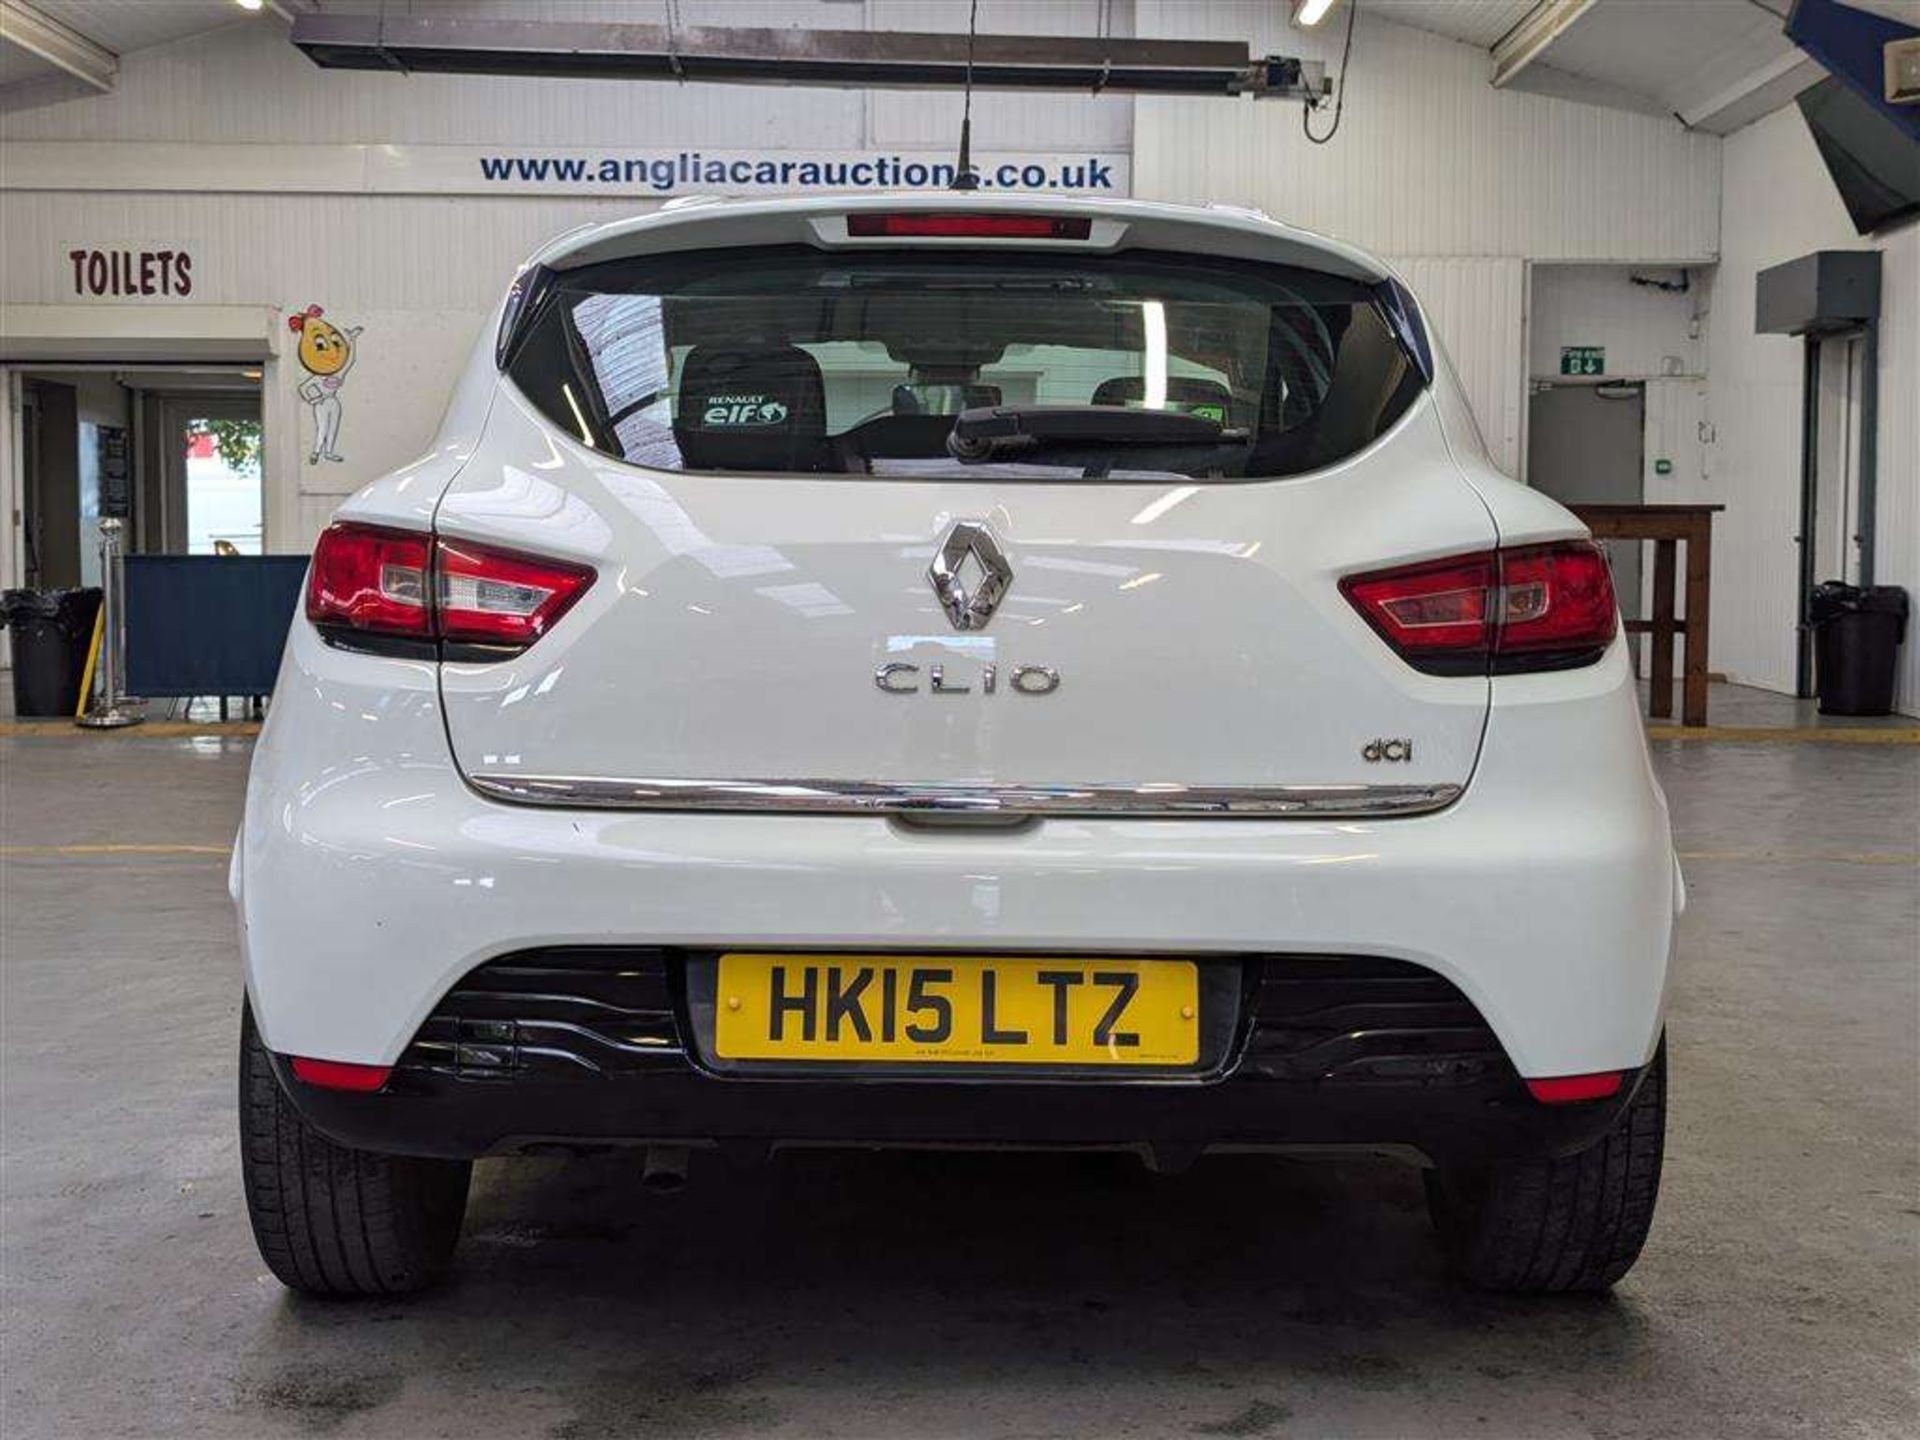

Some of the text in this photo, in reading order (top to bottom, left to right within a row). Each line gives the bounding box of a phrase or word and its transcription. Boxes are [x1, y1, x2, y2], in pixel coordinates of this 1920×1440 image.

[69, 250, 192, 296] TOILETS
[704, 404, 757, 423] elf
[708, 396, 764, 404] RENAULT
[875, 662, 1061, 694] CLIO
[768, 966, 1140, 1047] HK15 LTZ
